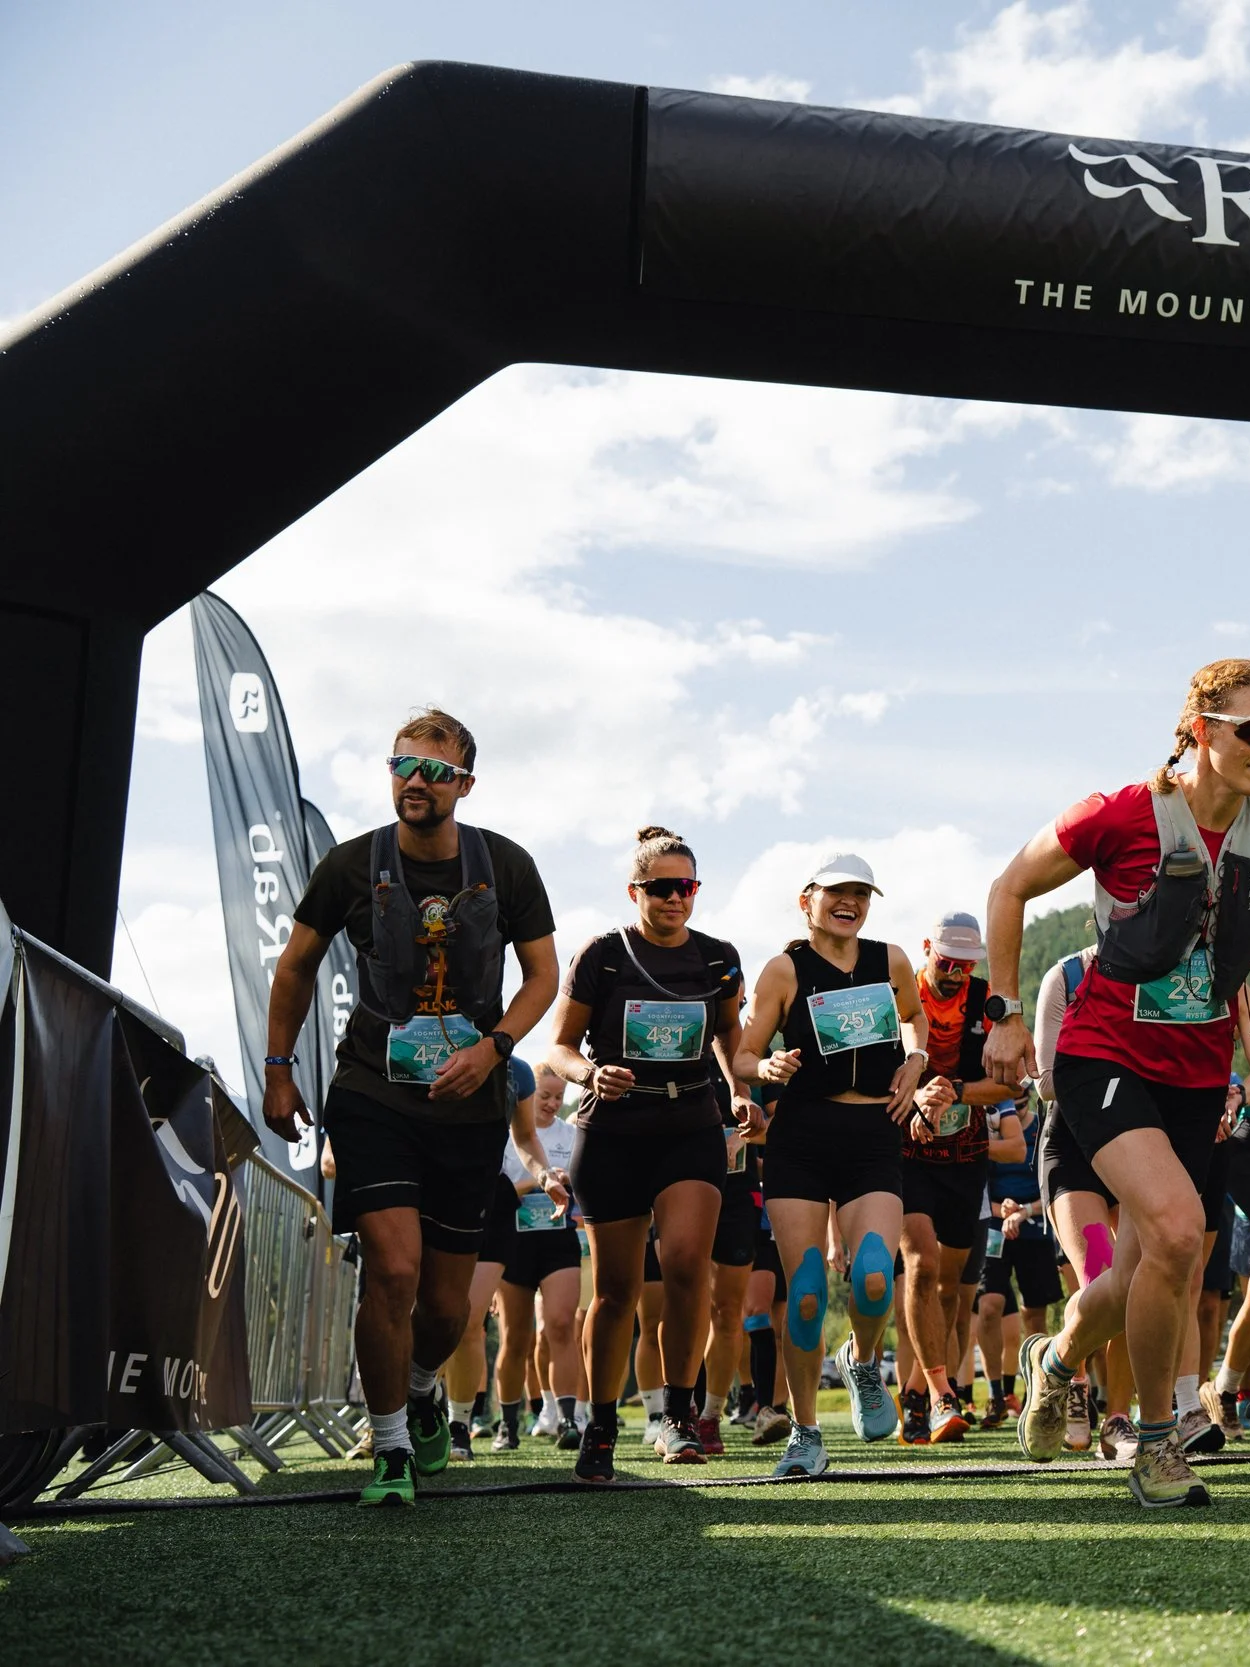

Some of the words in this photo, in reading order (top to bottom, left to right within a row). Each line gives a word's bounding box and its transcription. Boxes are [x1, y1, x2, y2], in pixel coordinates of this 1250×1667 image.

[1015, 280, 1093, 310] THE
[837, 1008, 876, 1032] 251
[646, 1026, 683, 1044] 431
